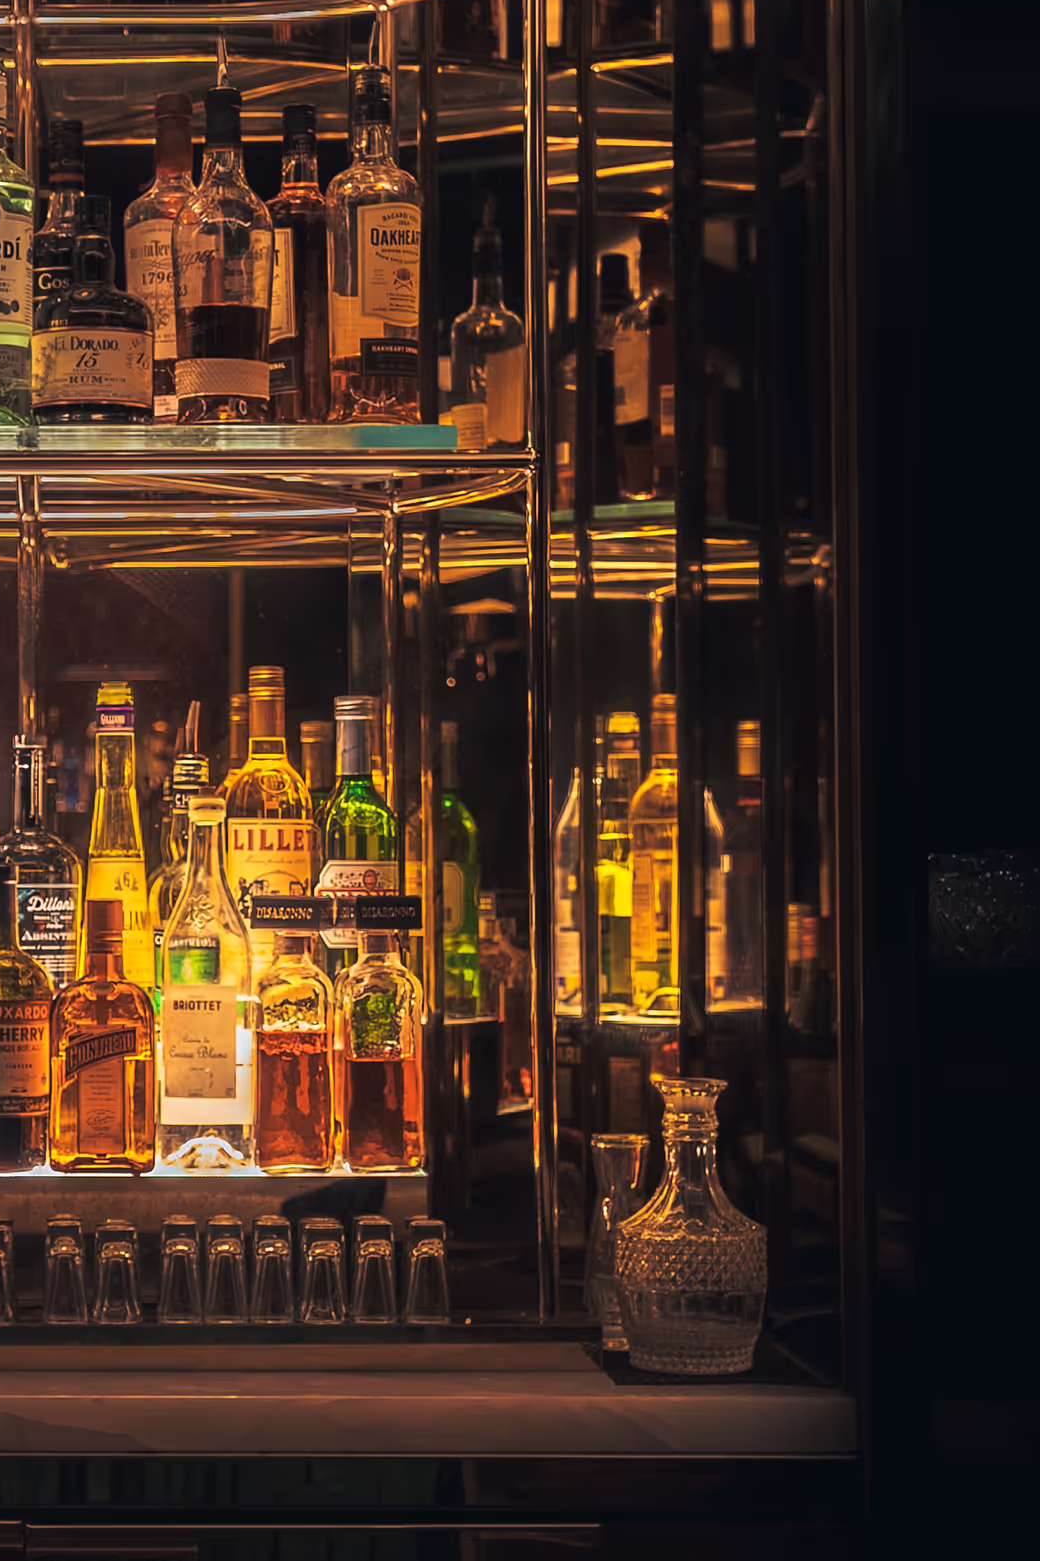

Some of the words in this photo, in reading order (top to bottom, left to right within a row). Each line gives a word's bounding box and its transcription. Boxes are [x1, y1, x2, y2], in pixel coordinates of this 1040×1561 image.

[370, 227, 420, 247] OAKHEAR
[70, 335, 120, 352] DORADO
[75, 351, 101, 369] 15
[69, 375, 103, 384] RUM
[173, 1000, 222, 1012] BRIOTTET
